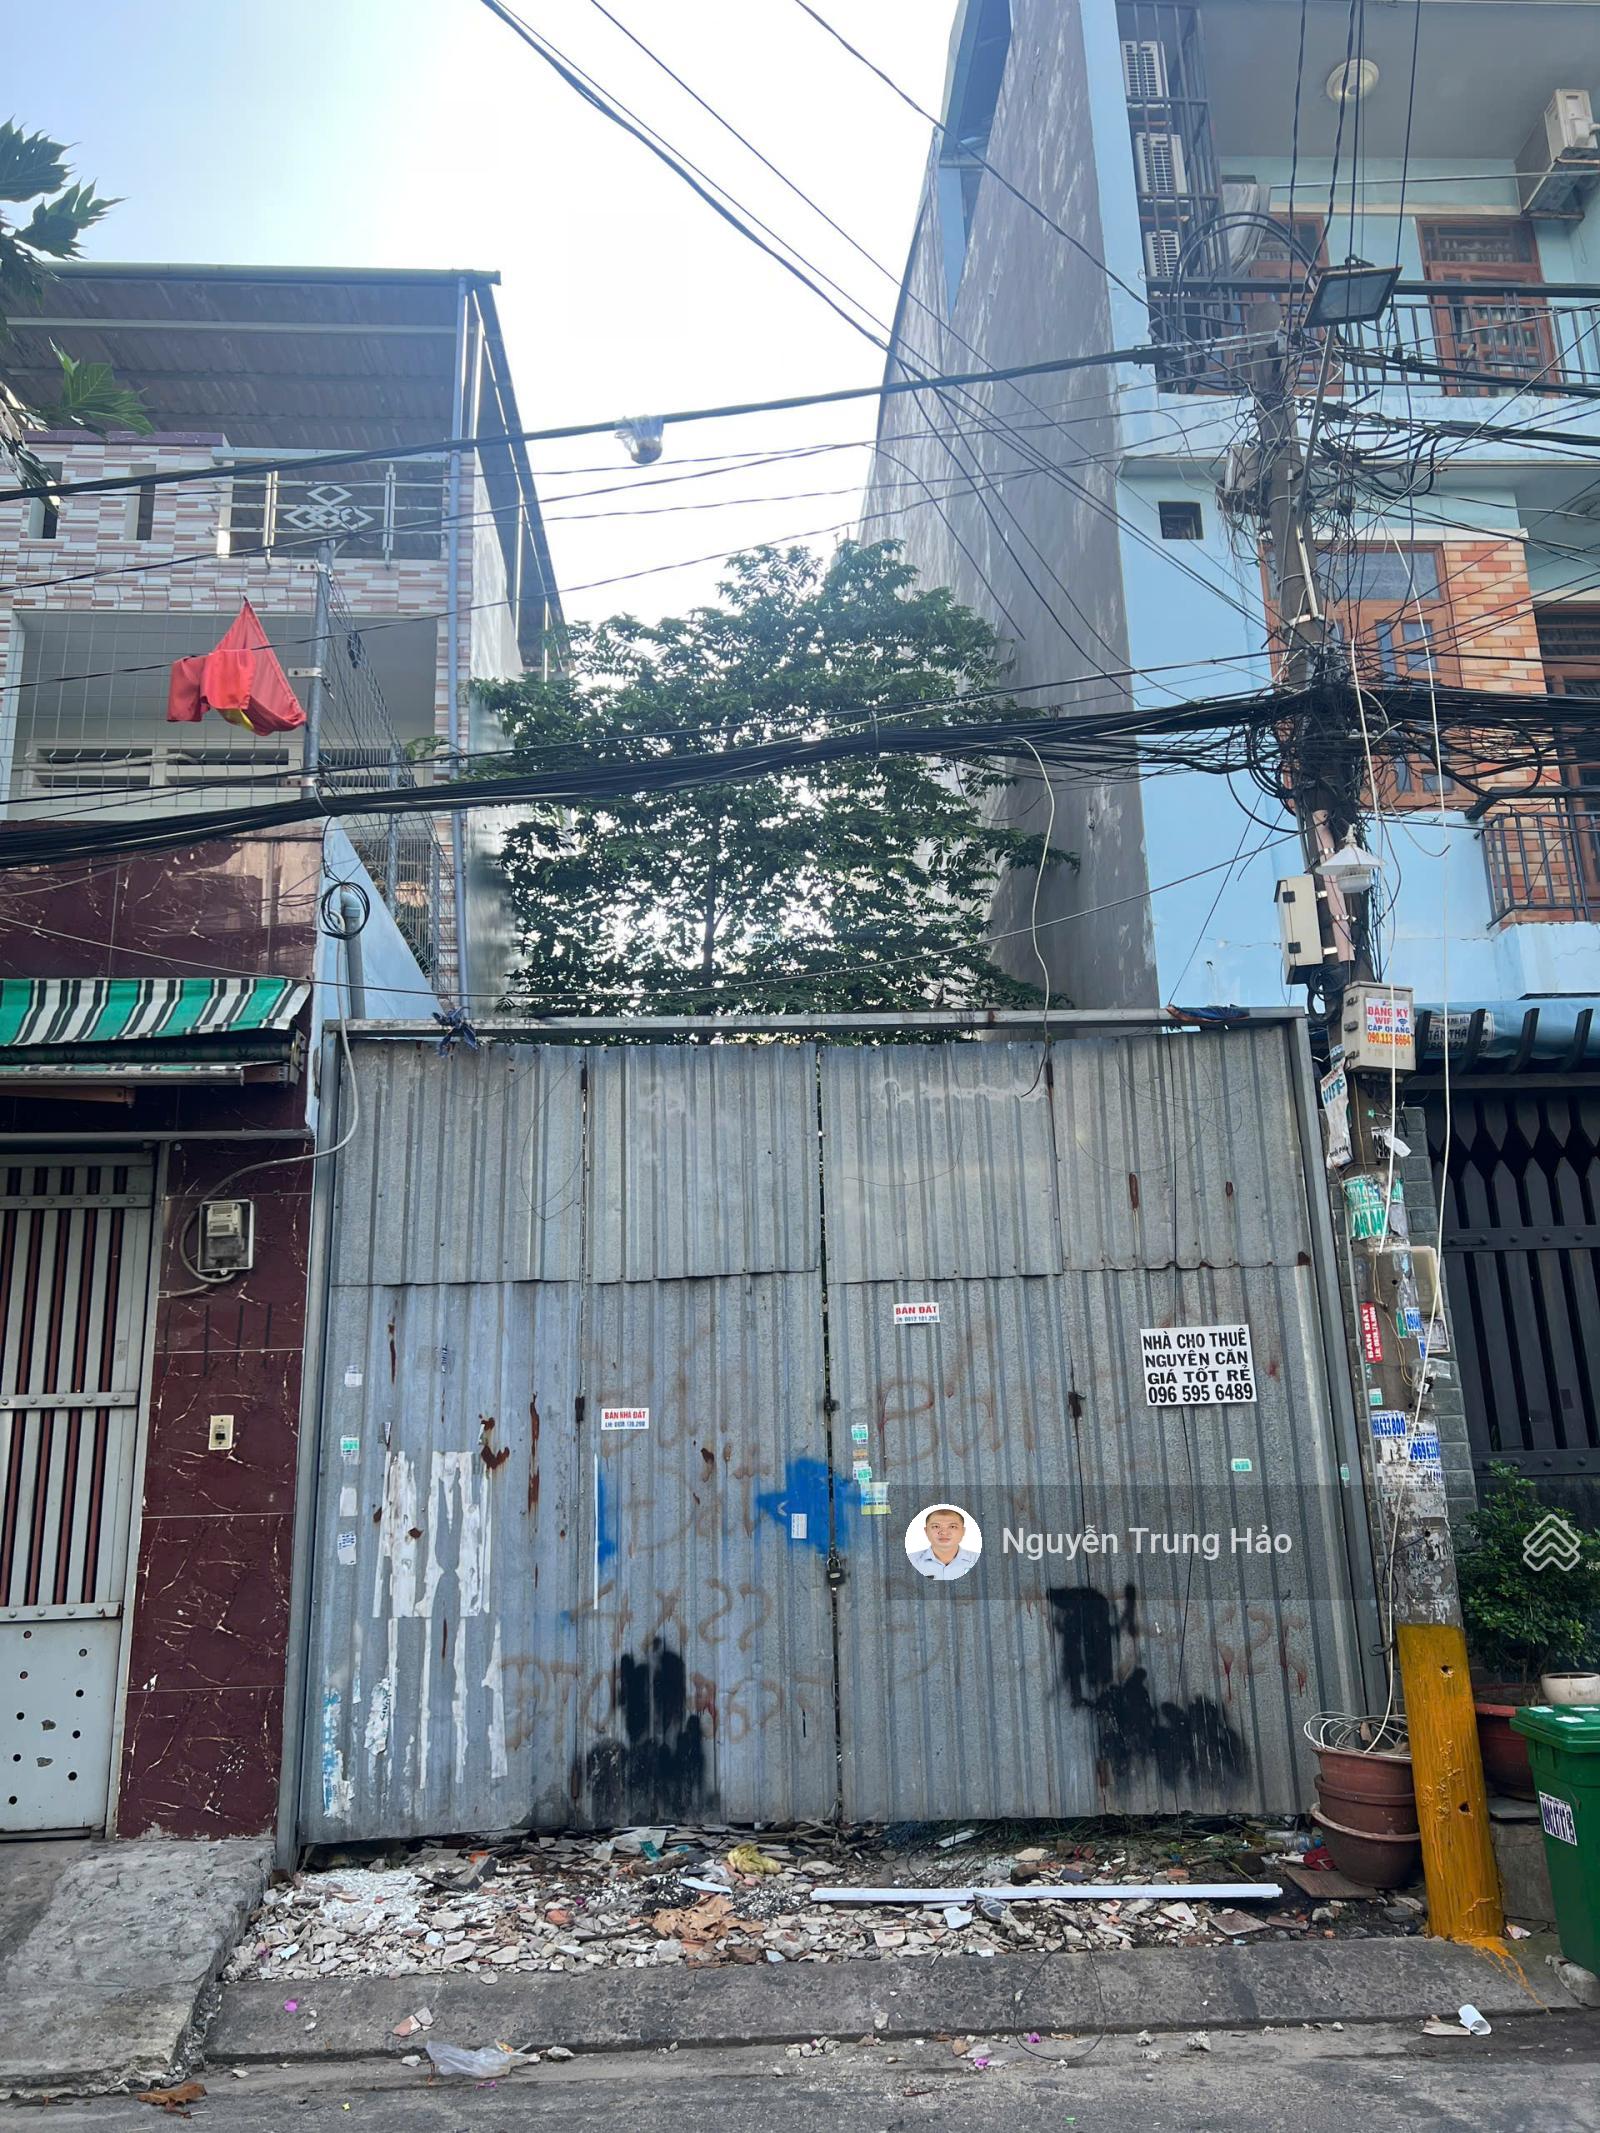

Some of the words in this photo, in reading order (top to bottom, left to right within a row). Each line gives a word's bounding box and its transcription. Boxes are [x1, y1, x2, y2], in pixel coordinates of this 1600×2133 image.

[1143, 1331, 1172, 1350] NHÀ
[1176, 1333, 1205, 1349] CHO
[1209, 1328, 1247, 1347] THUÊ
[1145, 1350, 1210, 1368] NGUYÊN
[1215, 1349, 1248, 1365] CĂN
[1147, 1369, 1177, 1384] GIÁ
[1184, 1366, 1219, 1383] TỐT
[1226, 1364, 1251, 1381] RẺ
[1148, 1386, 1177, 1403] 096
[1182, 1385, 1210, 1402] 595
[1215, 1383, 1253, 1400] 6489
